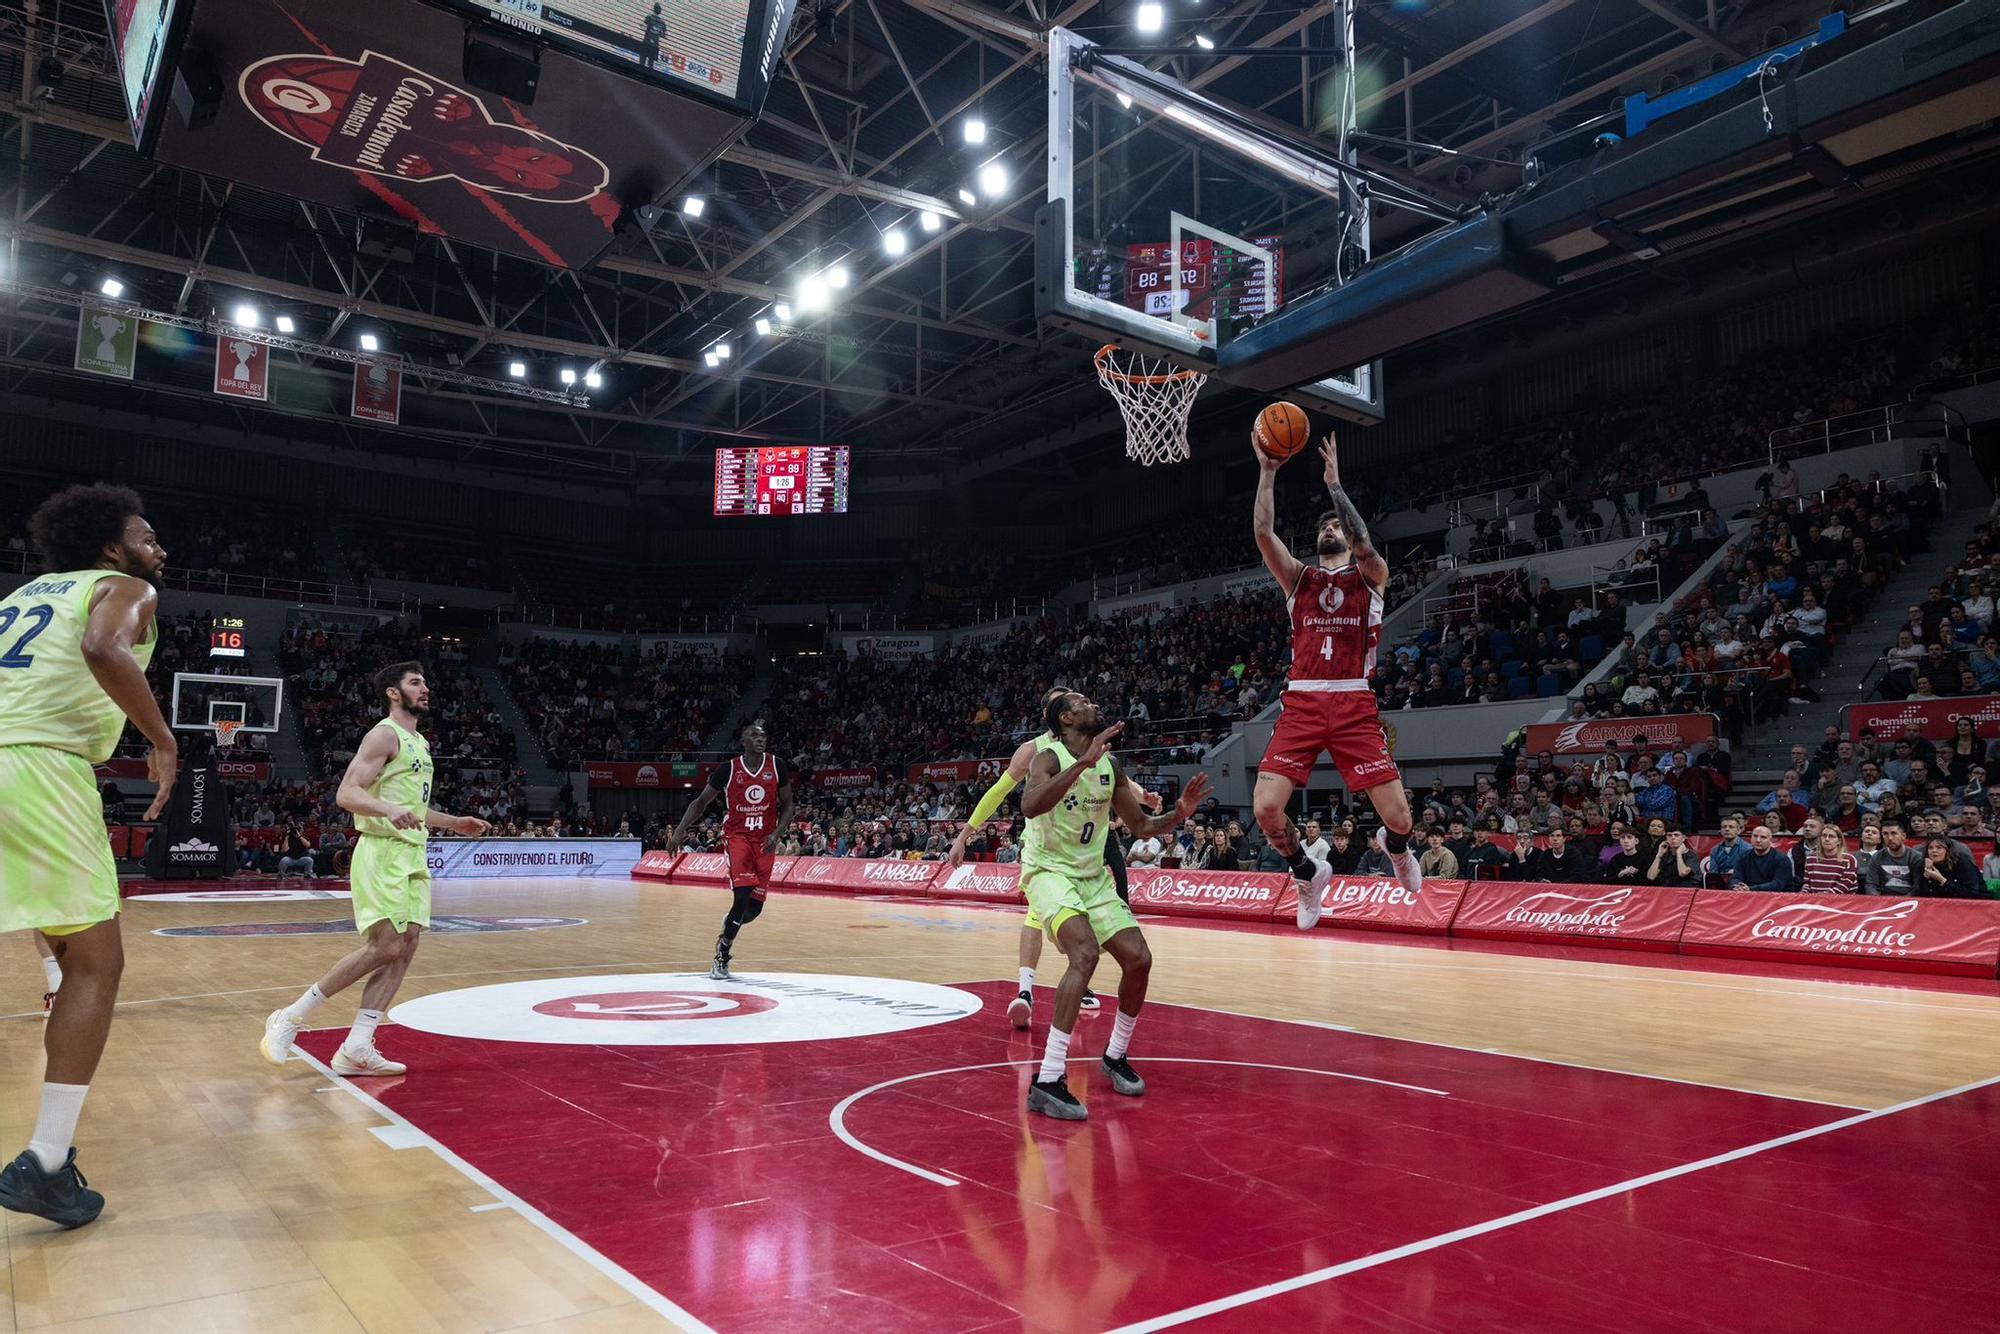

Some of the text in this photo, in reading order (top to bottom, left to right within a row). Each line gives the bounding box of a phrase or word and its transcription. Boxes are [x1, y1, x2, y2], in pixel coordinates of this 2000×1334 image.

[500, 14, 542, 35] MONDO
[339, 92, 378, 137] ZARAGOZA
[356, 77, 434, 171] Casademont
[221, 378, 262, 391] COPA DEL REY
[765, 464, 799, 474] 97 89
[763, 505, 768, 513] 5
[793, 504, 799, 512] 5
[222, 618, 244, 627] 1:26
[1302, 614, 1361, 627] Casademont
[218, 632, 241, 648] 16
[672, 640, 715, 650] Zaragoza
[875, 638, 920, 650] Zaragoza
[1320, 636, 1333, 661] 4
[1868, 717, 1929, 728] Chemieuro
[1580, 722, 1678, 741] GARMONTRU
[191, 774, 204, 825] SOMMOS
[422, 781, 430, 804] 8
[745, 816, 764, 831] 44
[1080, 821, 1095, 845] 0
[171, 852, 217, 863] SOMMOS
[473, 852, 594, 866] CONSTRUYENDO EL FUTURO
[869, 862, 930, 881] AMBAR
[1173, 879, 1271, 901] Sartopina
[1332, 879, 1422, 906] levitec
[1505, 906, 1626, 930] Campodulce
[1547, 925, 1617, 935] CURADOS
[1751, 917, 1917, 946] Campodulce
[1811, 943, 1907, 956] CURADOS
